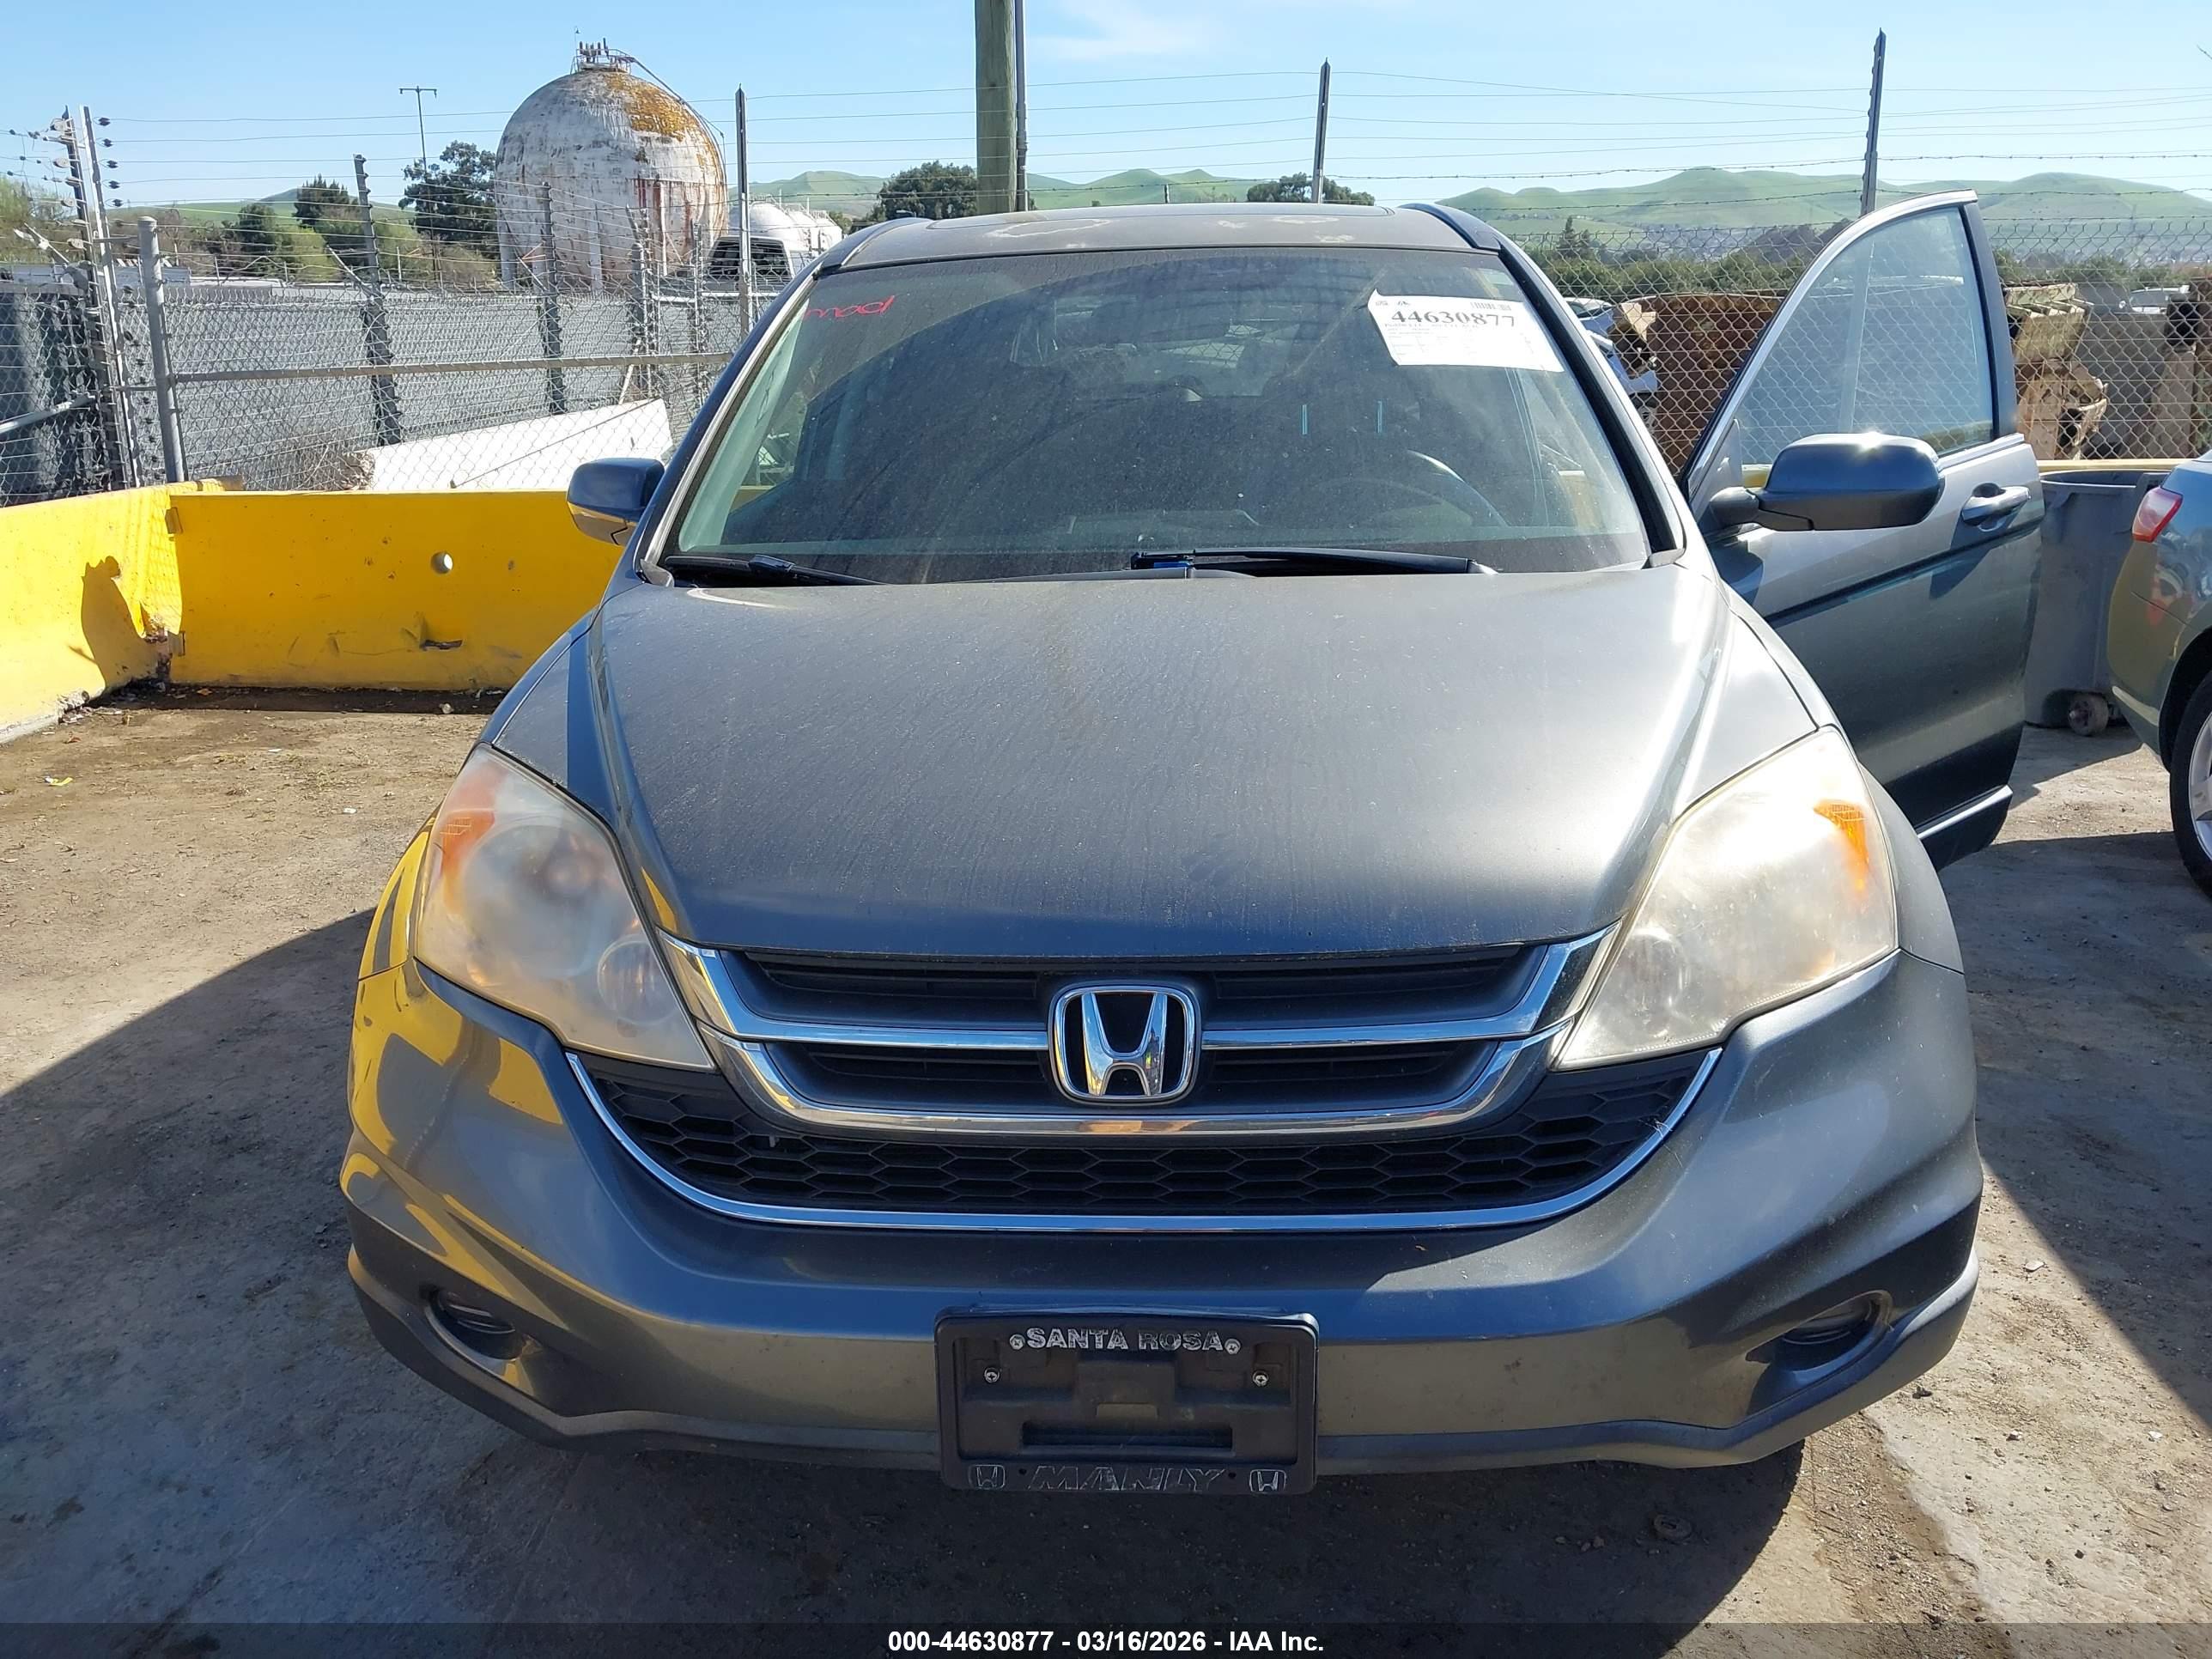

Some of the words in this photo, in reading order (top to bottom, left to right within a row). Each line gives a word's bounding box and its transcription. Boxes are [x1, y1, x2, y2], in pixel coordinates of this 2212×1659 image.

[1390, 310, 1515, 327] 44630877
[1025, 1328, 1129, 1351] SANTA
[1138, 1331, 1224, 1351] ROSA
[1027, 1465, 1226, 1492] MANLY
